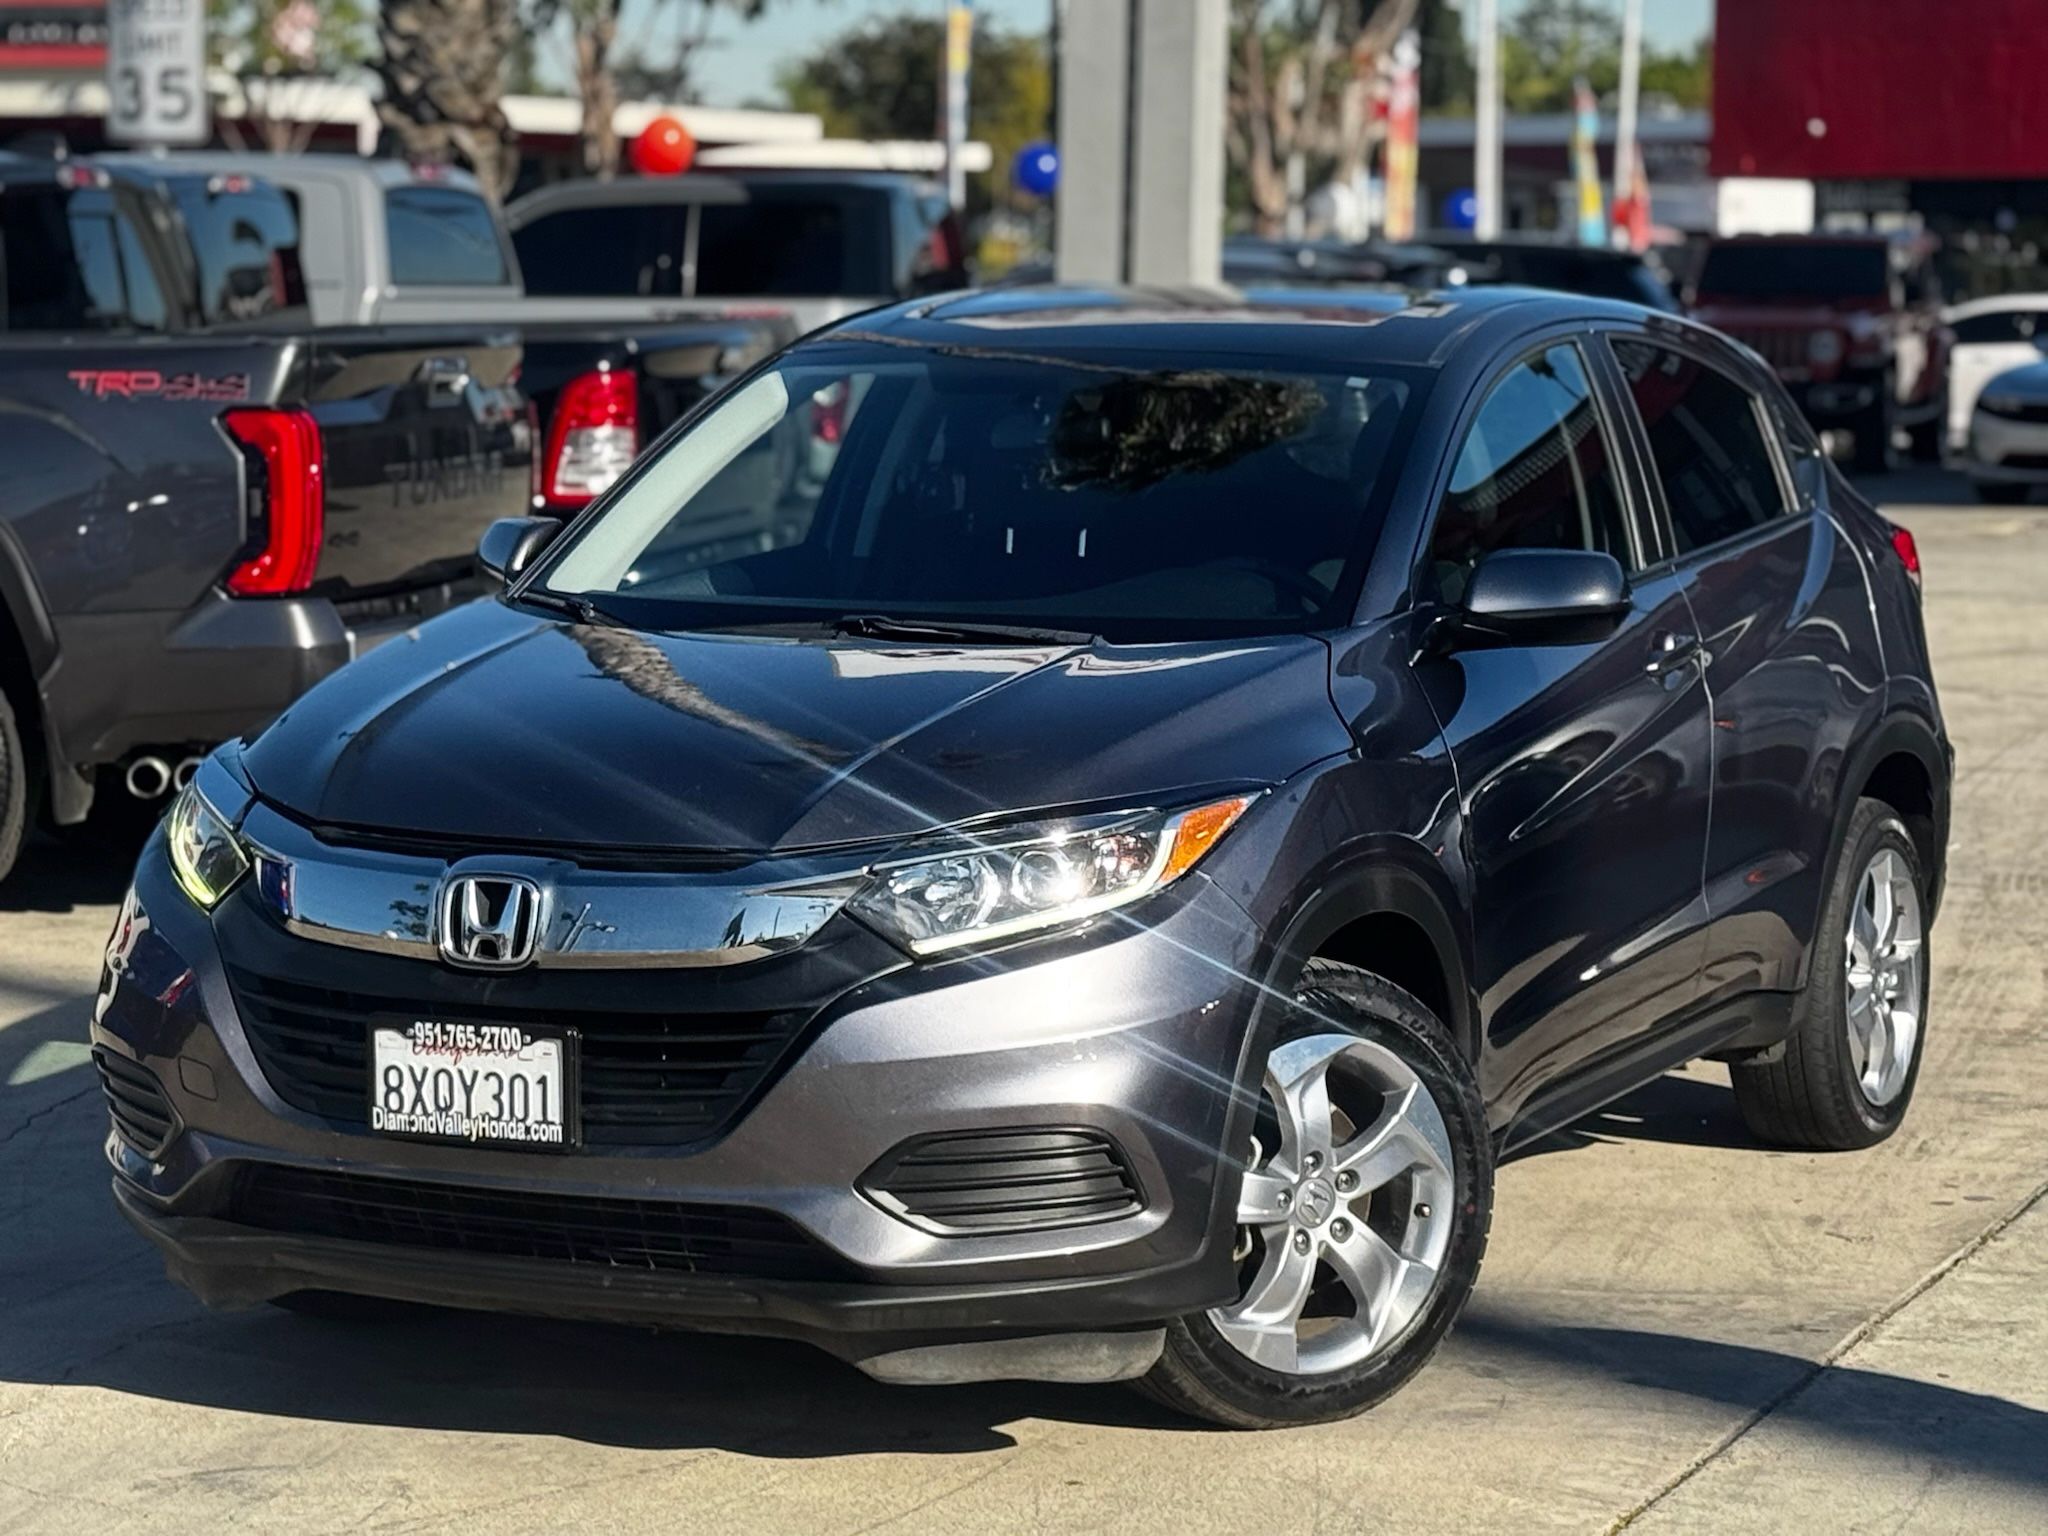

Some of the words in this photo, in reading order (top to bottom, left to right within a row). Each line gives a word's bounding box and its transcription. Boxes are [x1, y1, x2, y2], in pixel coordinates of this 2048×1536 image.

[118, 66, 193, 123] 35
[67, 370, 161, 398] TRD
[383, 1064, 549, 1122] 8XQY301
[372, 1106, 563, 1143] DiamondValleyHonda.com
